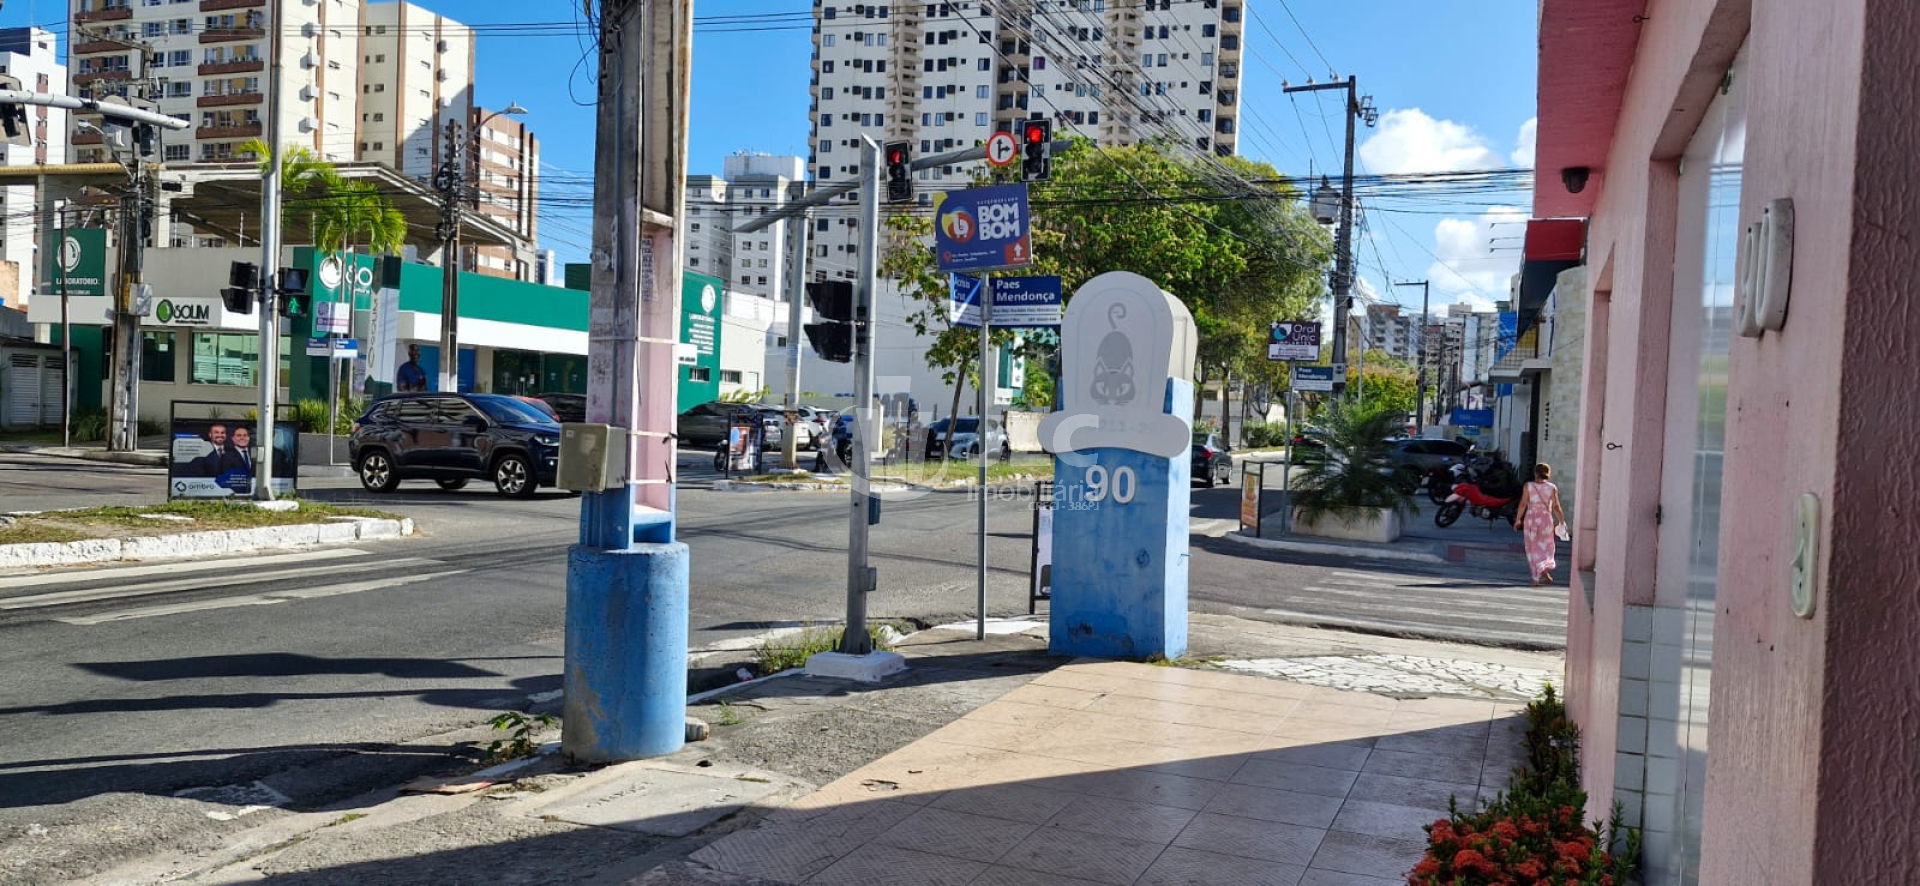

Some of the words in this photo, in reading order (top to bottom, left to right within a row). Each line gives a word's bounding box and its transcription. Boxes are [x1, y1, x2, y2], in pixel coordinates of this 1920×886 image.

[978, 202, 1019, 223] BOM
[979, 220, 1020, 241] BOM
[996, 280, 1020, 289] Paes
[996, 291, 1055, 302] Mendonça
[174, 304, 210, 319] SOLIM
[1293, 324, 1316, 333] Oral
[1292, 332, 1316, 341] Unic
[1084, 465, 1136, 504] 90
